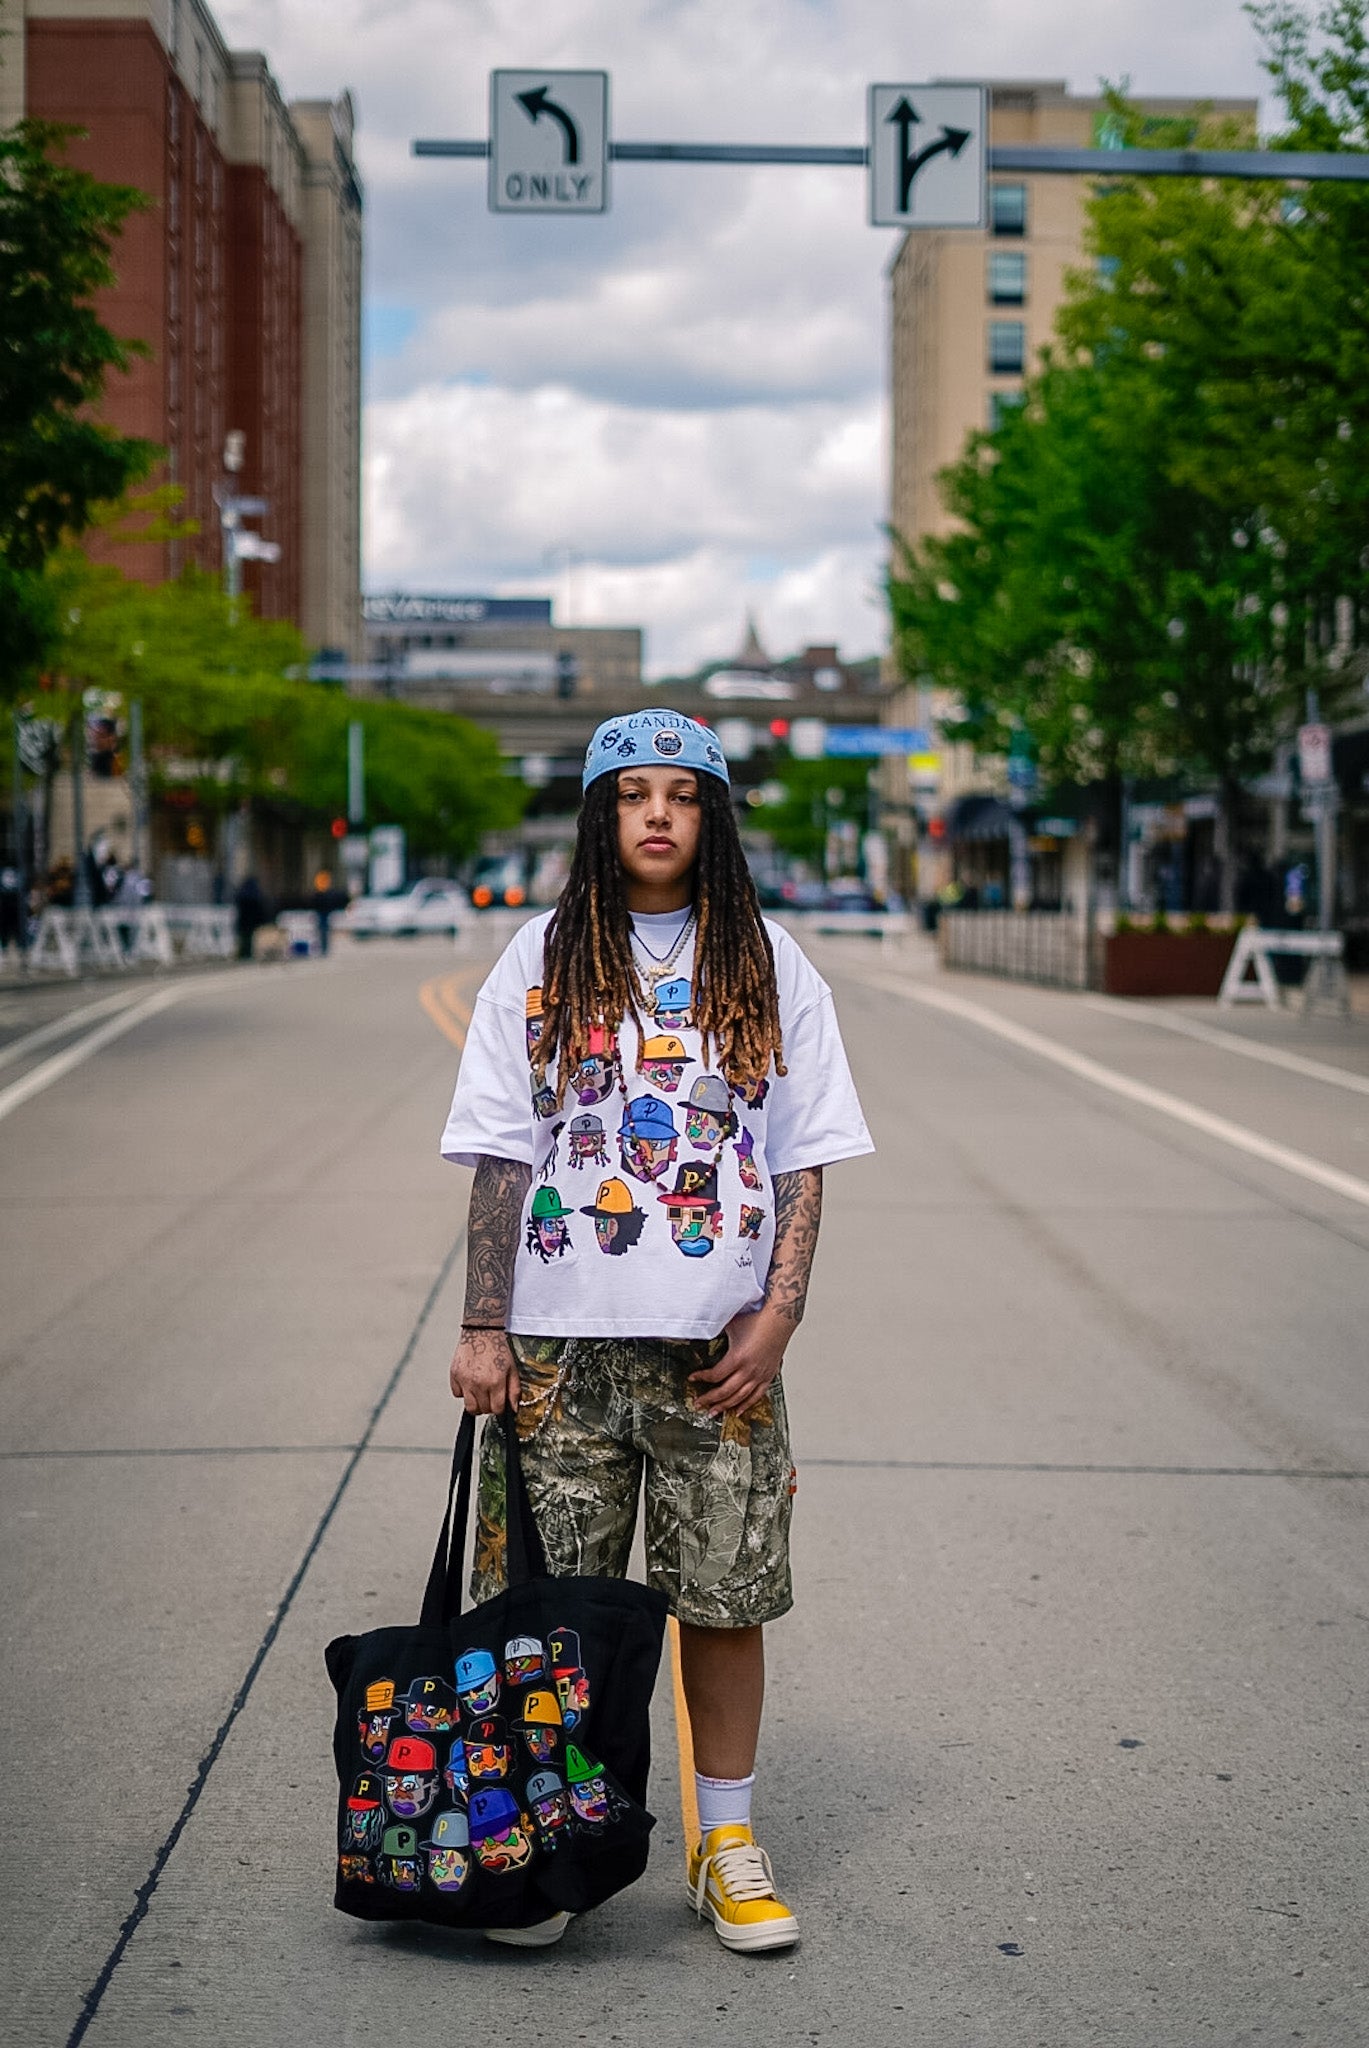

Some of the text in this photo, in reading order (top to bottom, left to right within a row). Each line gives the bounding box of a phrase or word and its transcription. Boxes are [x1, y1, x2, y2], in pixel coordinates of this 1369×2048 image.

[506, 173, 590, 201] ONLY
[643, 1102, 658, 1119] P
[581, 1119, 592, 1129] P
[683, 1169, 699, 1192] P
[598, 1186, 610, 1204] P
[550, 1641, 563, 1663] P
[461, 1661, 472, 1675] P
[423, 1681, 436, 1693] P
[527, 1697, 540, 1714] P
[481, 1722, 495, 1738] P
[398, 1746, 411, 1760] P
[358, 1780, 370, 1796] P
[532, 1778, 546, 1793] P
[475, 1797, 488, 1815] P
[437, 1819, 448, 1840] P
[398, 1832, 411, 1849] P
